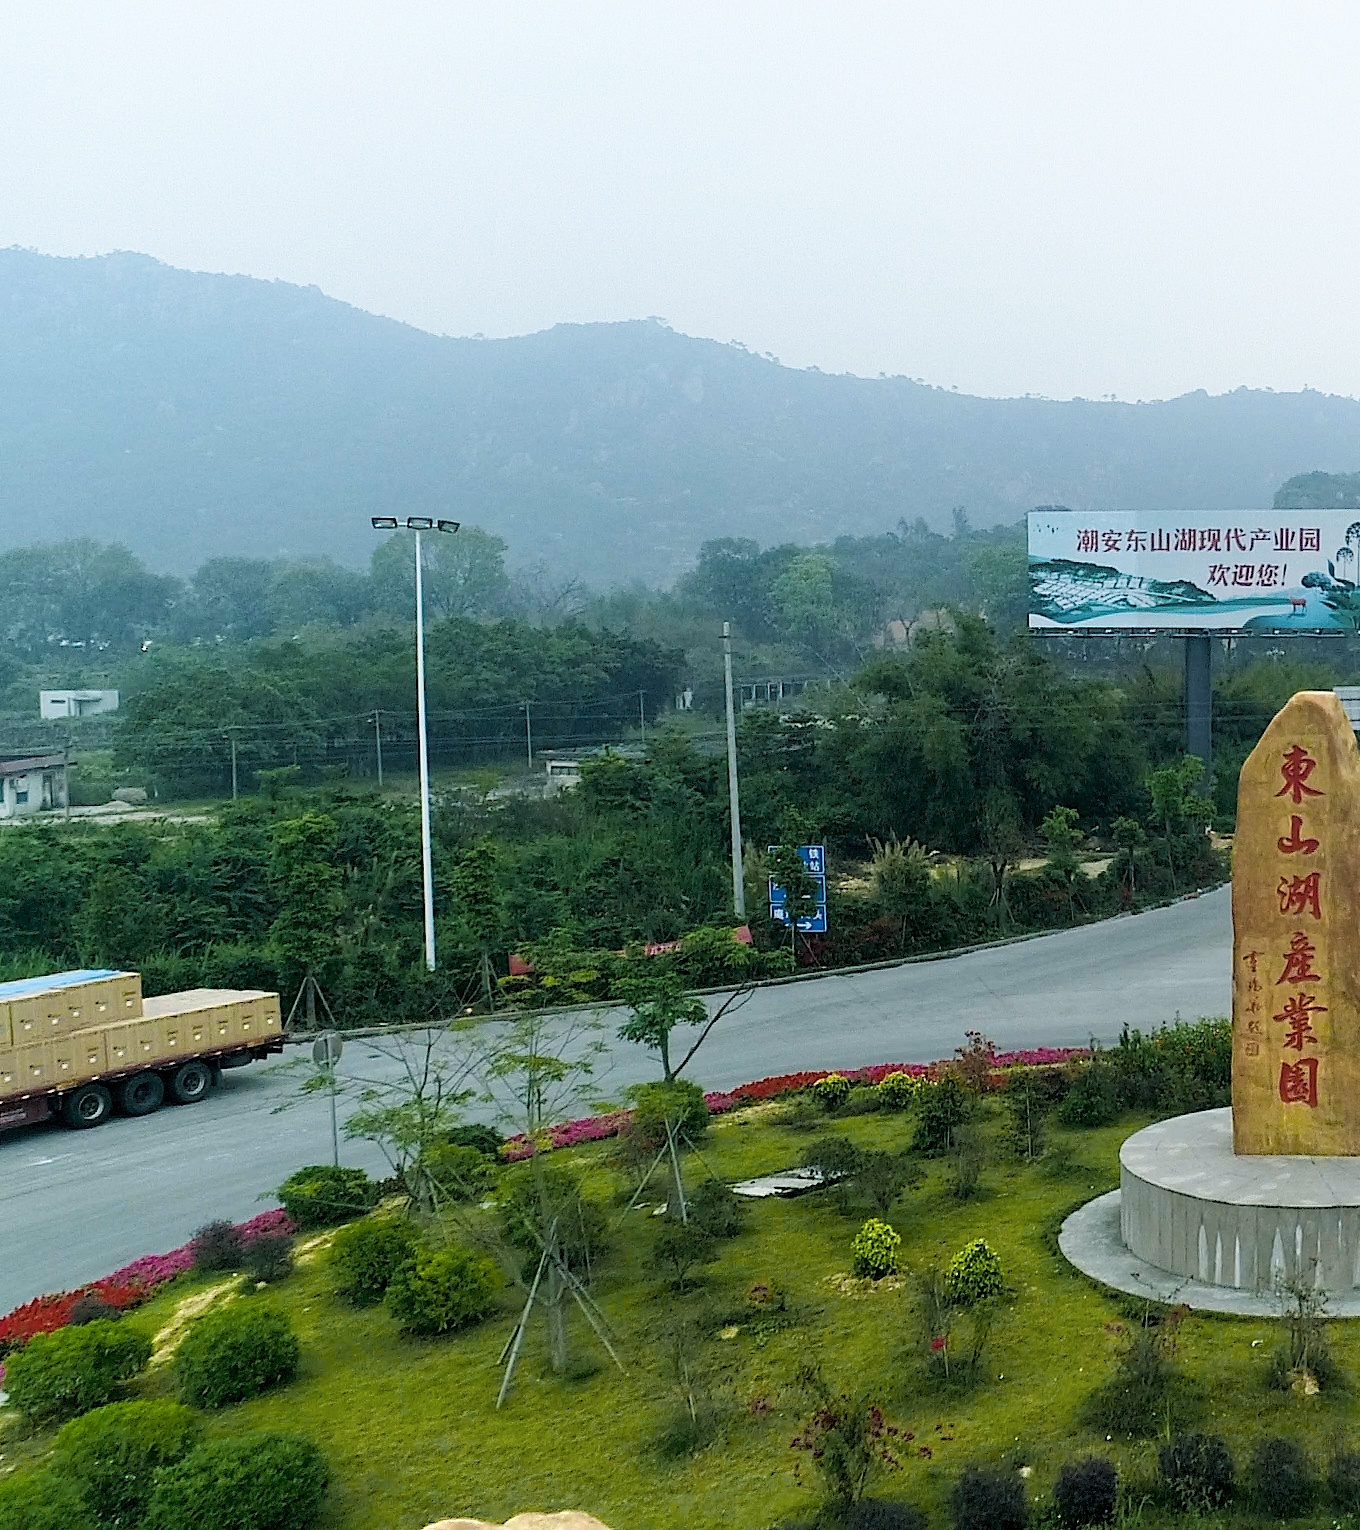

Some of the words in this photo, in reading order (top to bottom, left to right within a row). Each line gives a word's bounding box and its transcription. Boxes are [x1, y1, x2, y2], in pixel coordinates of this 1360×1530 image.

[1076, 528, 1321, 552] 潮安东山湖现代产业园
[1206, 563, 1287, 587] 欢迎您!
